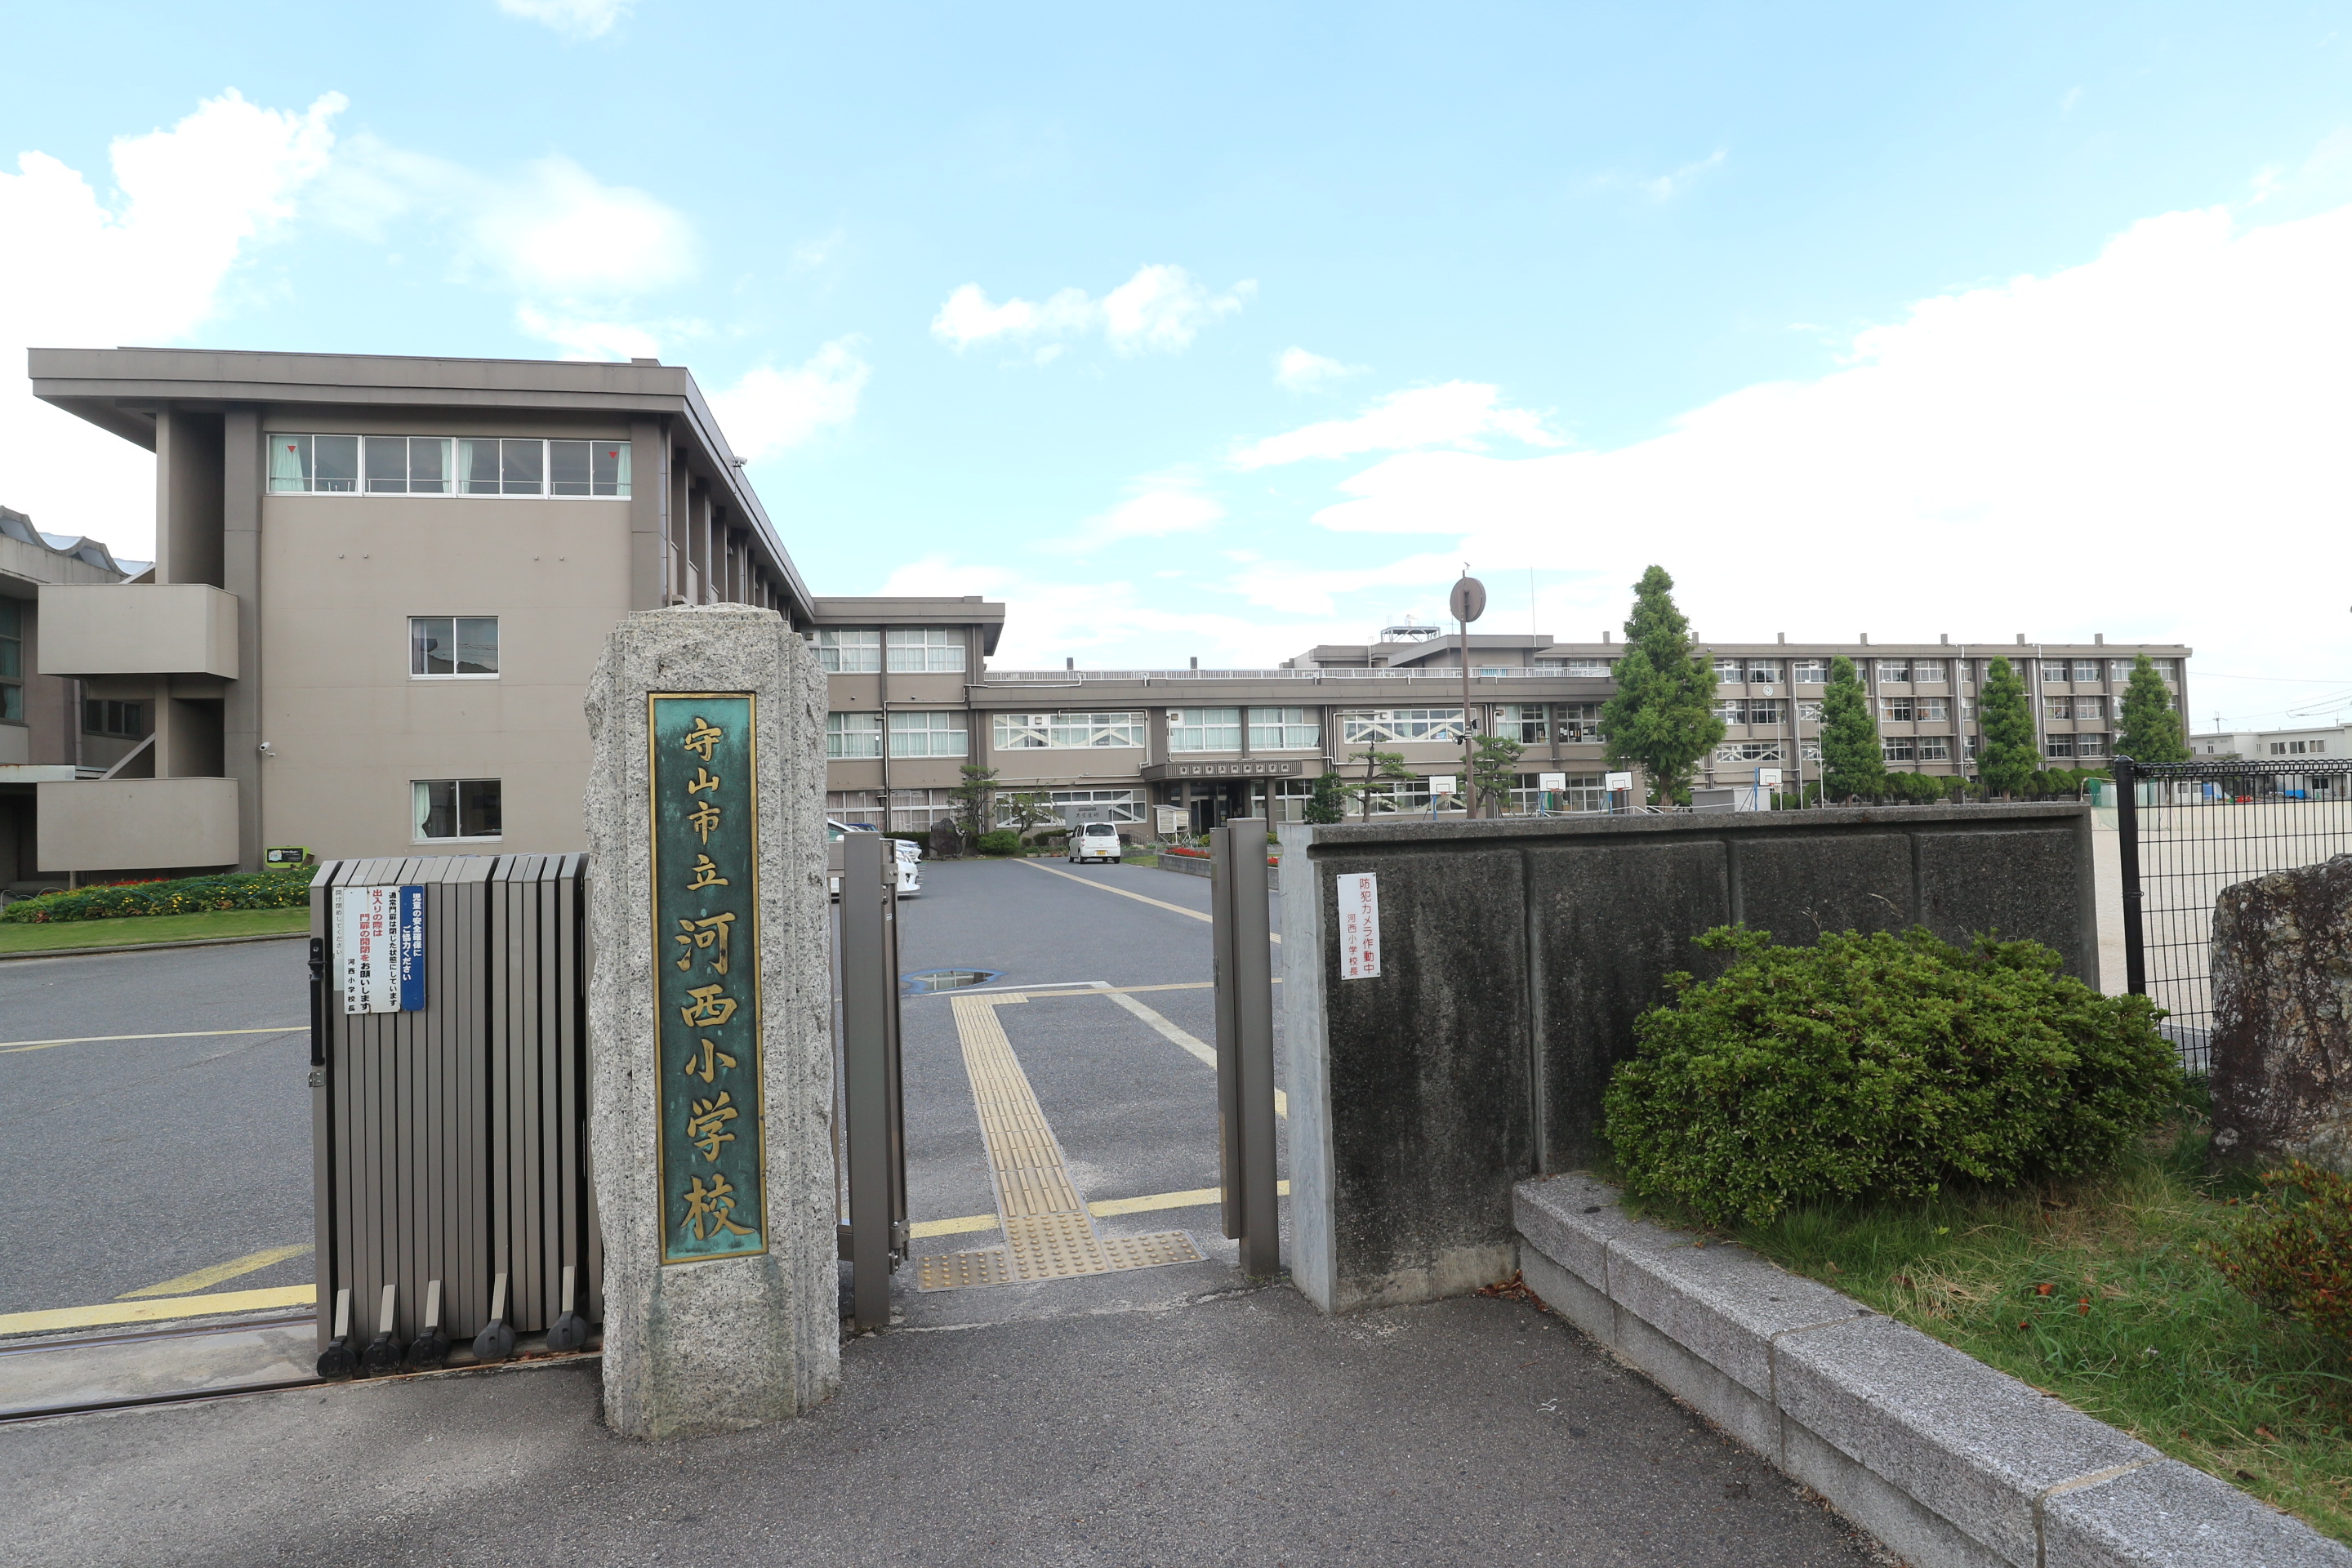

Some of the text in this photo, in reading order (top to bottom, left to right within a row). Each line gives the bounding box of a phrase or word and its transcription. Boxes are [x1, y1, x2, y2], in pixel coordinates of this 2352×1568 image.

[372, 889, 383, 937] 出入りの際は
[412, 893, 421, 957] 児童の安全確保に
[1347, 913, 1359, 976] 河西小学校長
[1360, 878, 1374, 974] 防犯カメラ作動中
[389, 891, 398, 1006] 通常門扉は閉じた状態にしています
[402, 925, 412, 981] ご協力ください
[675, 717, 759, 1241] 守山市立河西小学校
